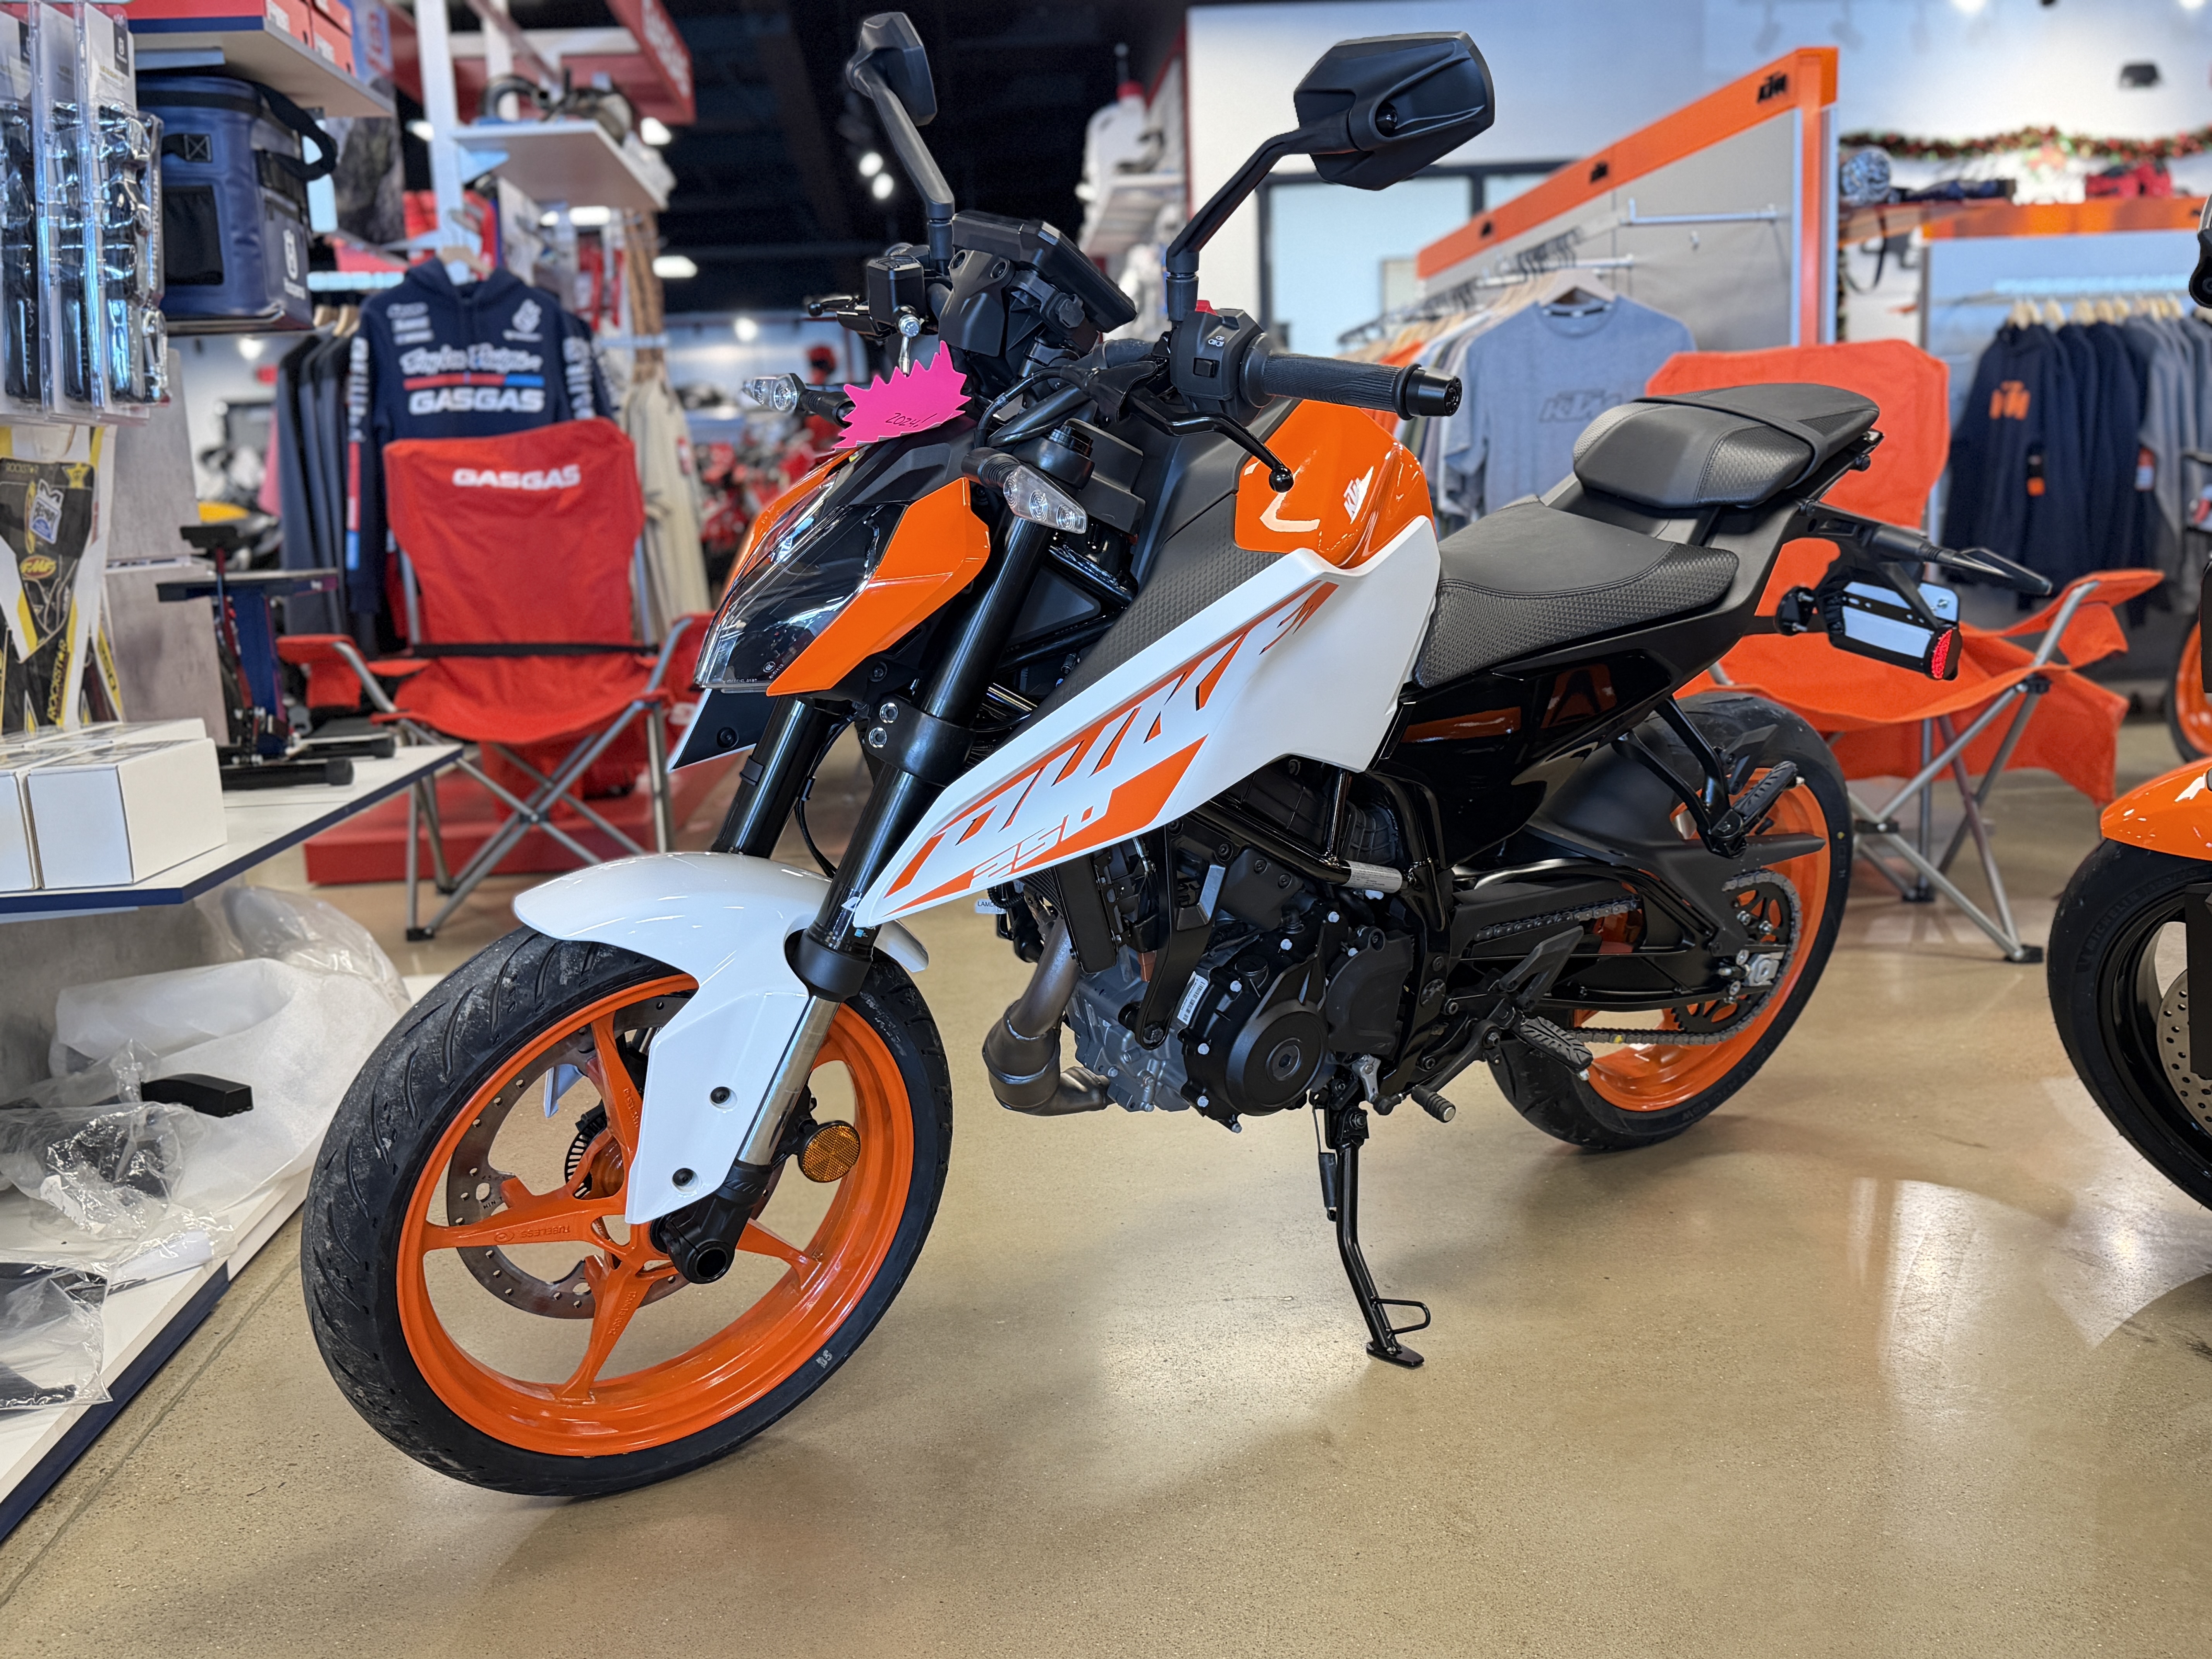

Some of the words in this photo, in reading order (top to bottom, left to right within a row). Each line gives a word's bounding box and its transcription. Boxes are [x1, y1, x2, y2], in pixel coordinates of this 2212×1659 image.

[409, 387, 545, 415] GASGAS
[453, 464, 580, 490] GASGAS
[21, 559, 57, 573] FMF
[969, 785, 1115, 891] 250
[483, 1200, 496, 1209] MIN
[520, 1224, 570, 1238] TUBELESS
